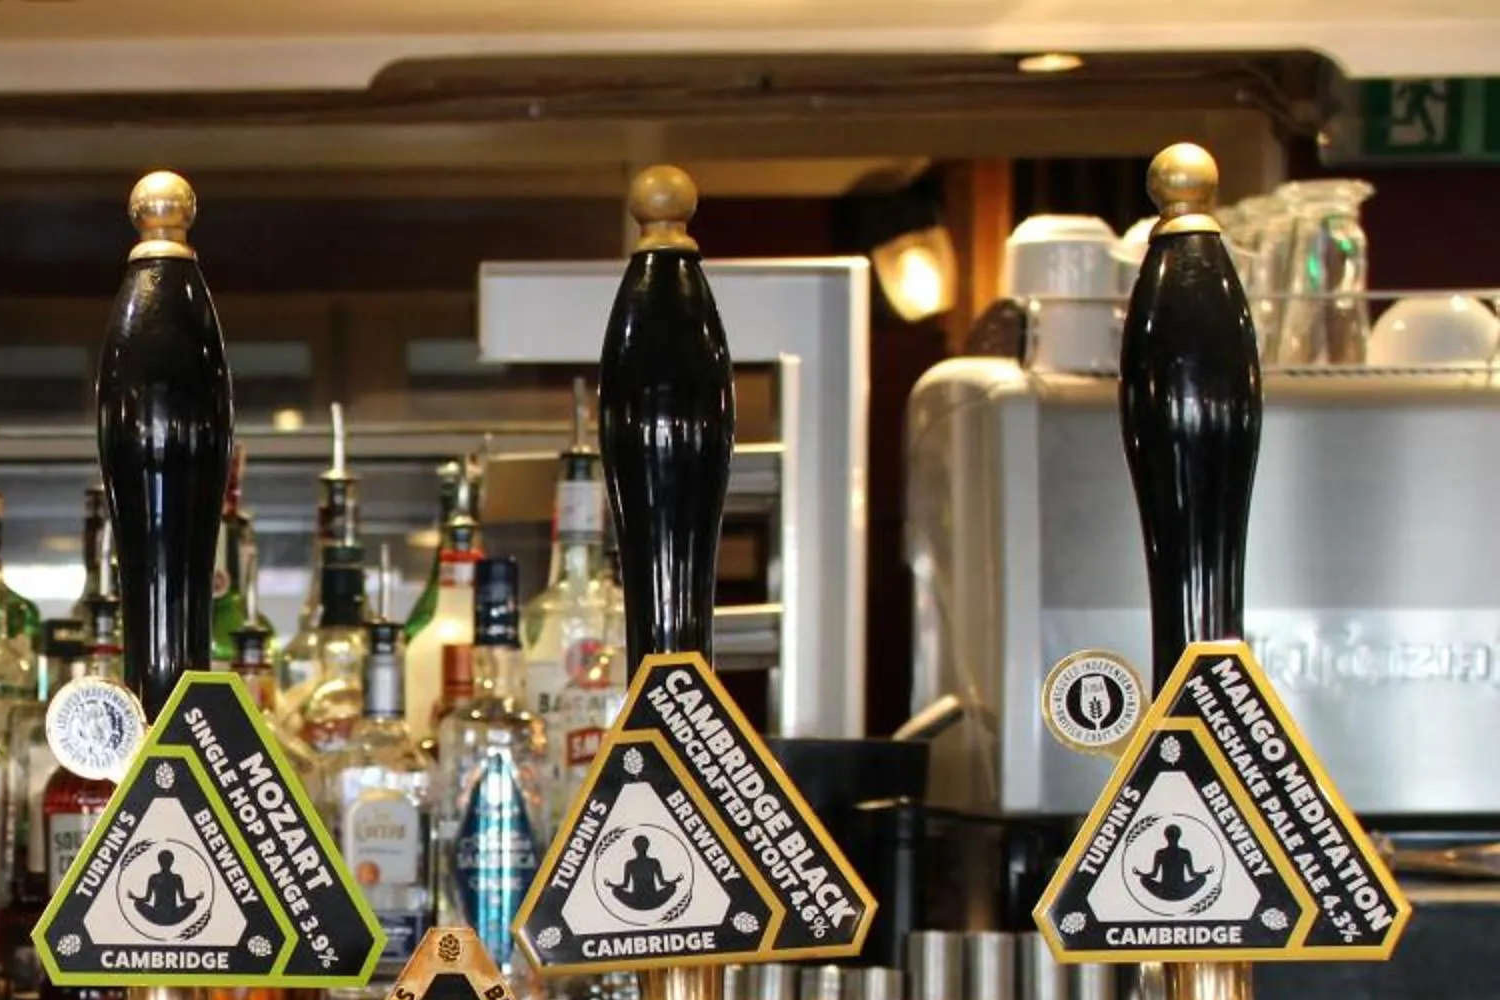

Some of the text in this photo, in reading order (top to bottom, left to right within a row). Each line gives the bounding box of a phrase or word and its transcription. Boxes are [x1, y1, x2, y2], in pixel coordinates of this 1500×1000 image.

[182, 707, 340, 969] SINGLE HOP RANGE 3.9%
[239, 751, 334, 892] MOZART
[550, 789, 741, 891] TURPIN'S BREWERY
[646, 685, 828, 939] HANDCRAFTED STOUT 4.6%
[665, 669, 856, 928] CAMBRIDGE BLACK
[1078, 779, 1274, 879] TURPIN'S BREWERY
[1185, 675, 1364, 944] MILKSHAKE PALE ALE 4.3%
[1211, 657, 1394, 933] MANGO MEDITATION
[75, 809, 136, 898] TURPIN'S
[193, 808, 259, 904] BREWERY
[100, 950, 229, 970] CAMBRIDGE
[581, 931, 717, 958] CAMBRIDGE
[1105, 925, 1243, 946] CAMBRIDGE
